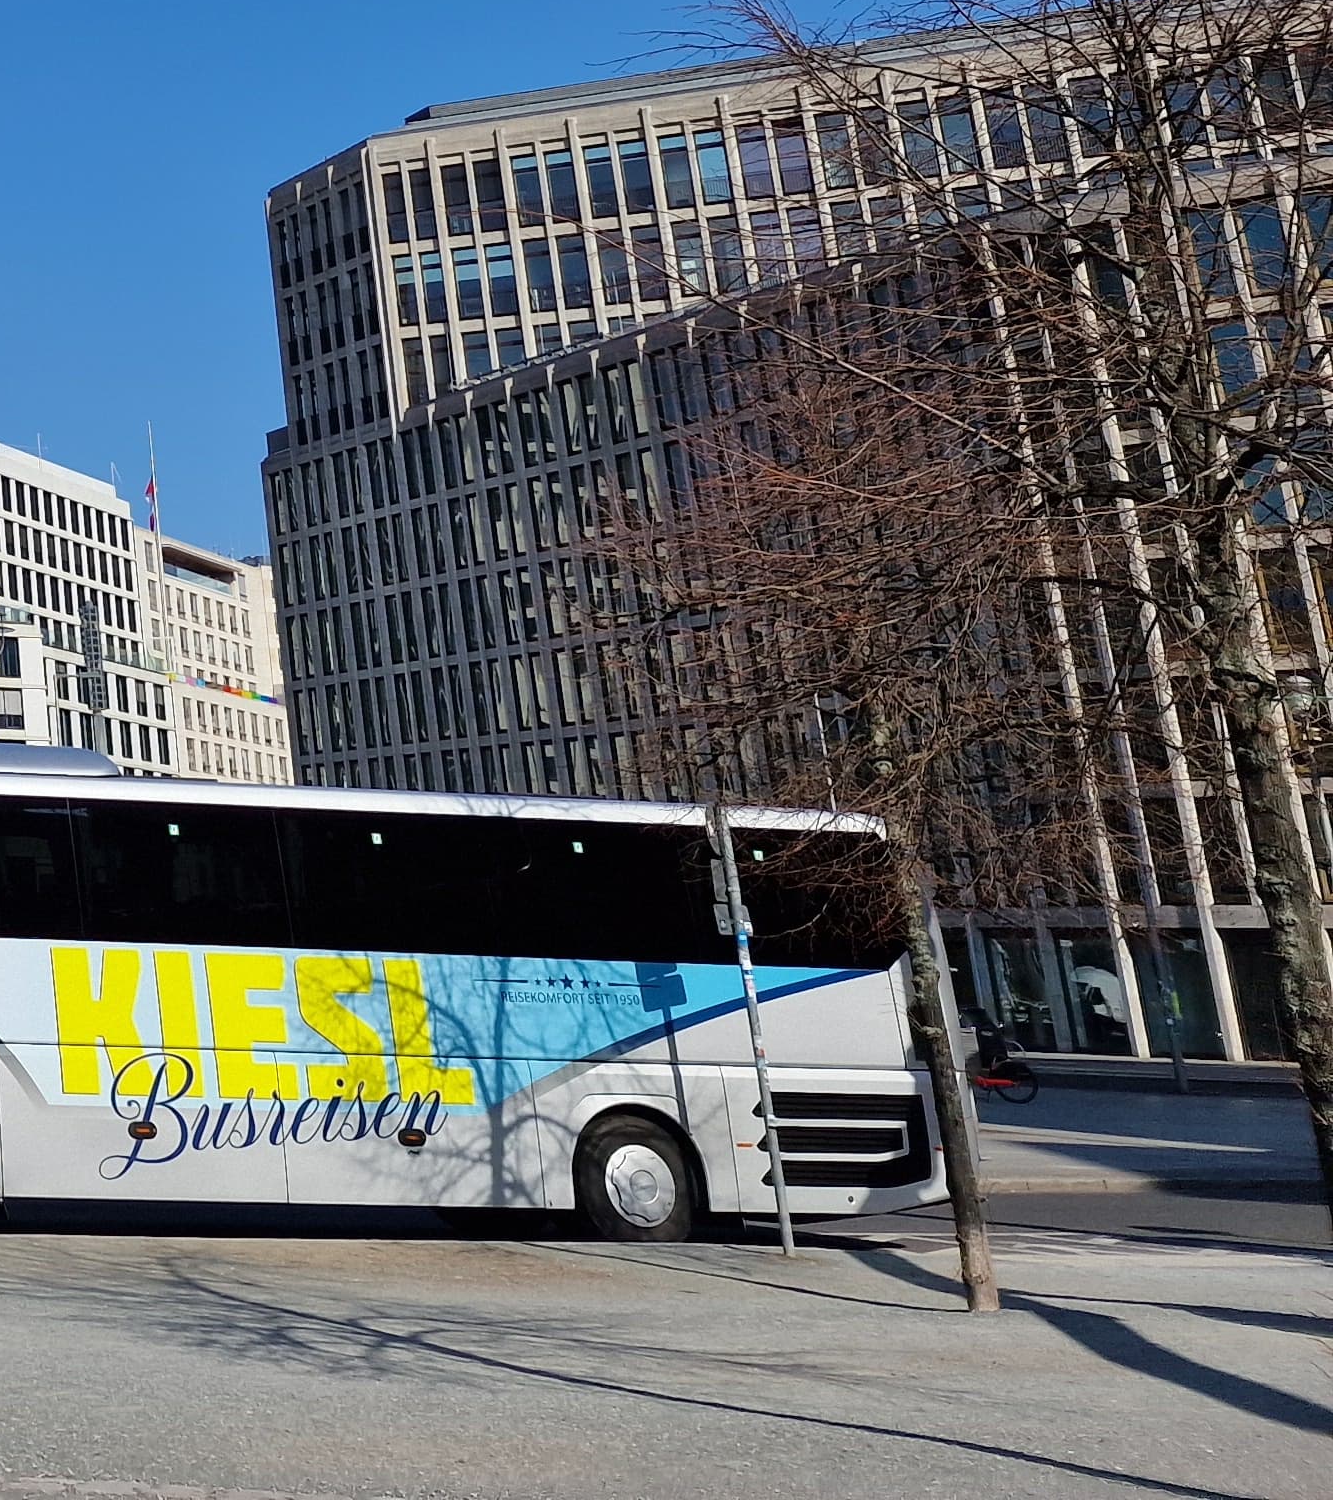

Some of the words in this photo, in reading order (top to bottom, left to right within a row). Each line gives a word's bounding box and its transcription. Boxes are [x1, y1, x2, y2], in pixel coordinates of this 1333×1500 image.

[49, 945, 477, 1106] KIESL
[501, 990, 584, 1005] REISEKOMFORT
[588, 993, 610, 1005] SEIT
[614, 994, 640, 1006] 1950
[99, 1052, 449, 1180] Busreisen
